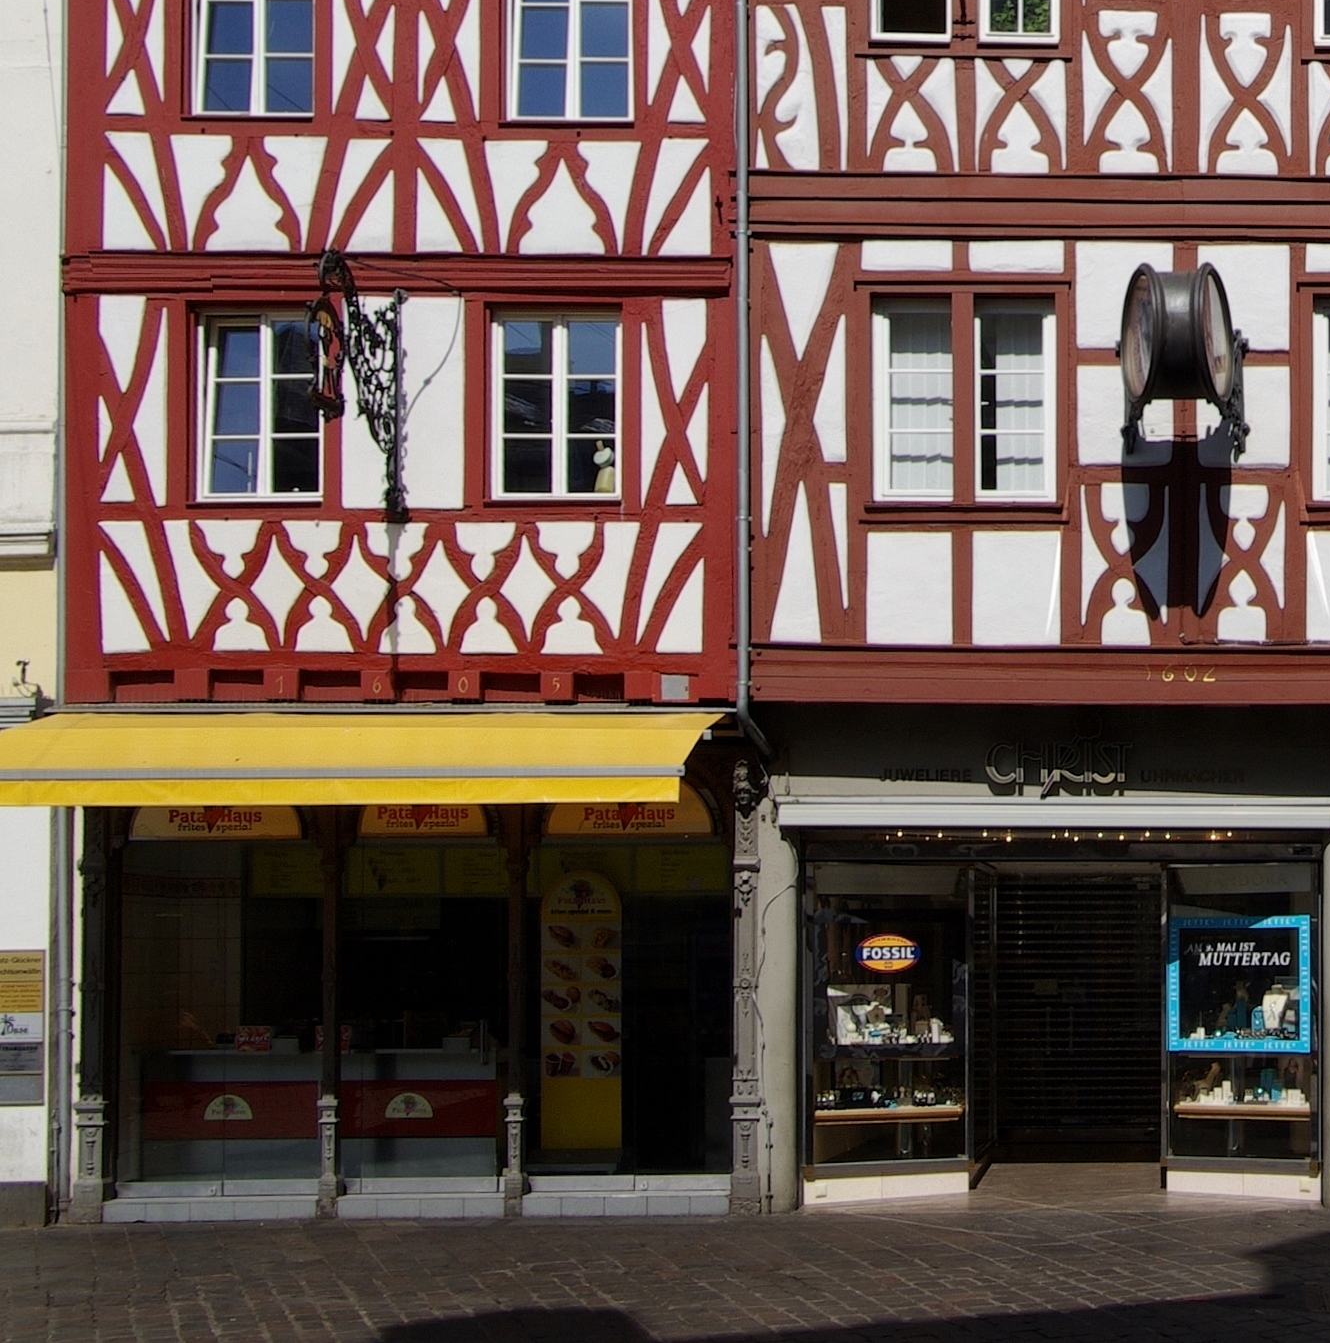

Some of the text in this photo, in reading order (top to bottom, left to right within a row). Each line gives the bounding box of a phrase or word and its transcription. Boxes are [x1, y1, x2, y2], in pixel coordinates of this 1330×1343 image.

[879, 768, 972, 783] JUWELIERE
[984, 741, 1133, 798] CHRIST
[169, 808, 263, 824] Pata Haus
[376, 805, 469, 821] Pata Haus
[583, 807, 675, 821] Pata Haus
[177, 822, 207, 832] frites
[385, 818, 414, 829] frites
[593, 819, 620, 829] frites
[862, 947, 915, 960] FOSSIL
[1216, 942, 1237, 952] MAI
[1239, 942, 1256, 952] IST
[1197, 951, 1292, 967] MUTTERTAG
